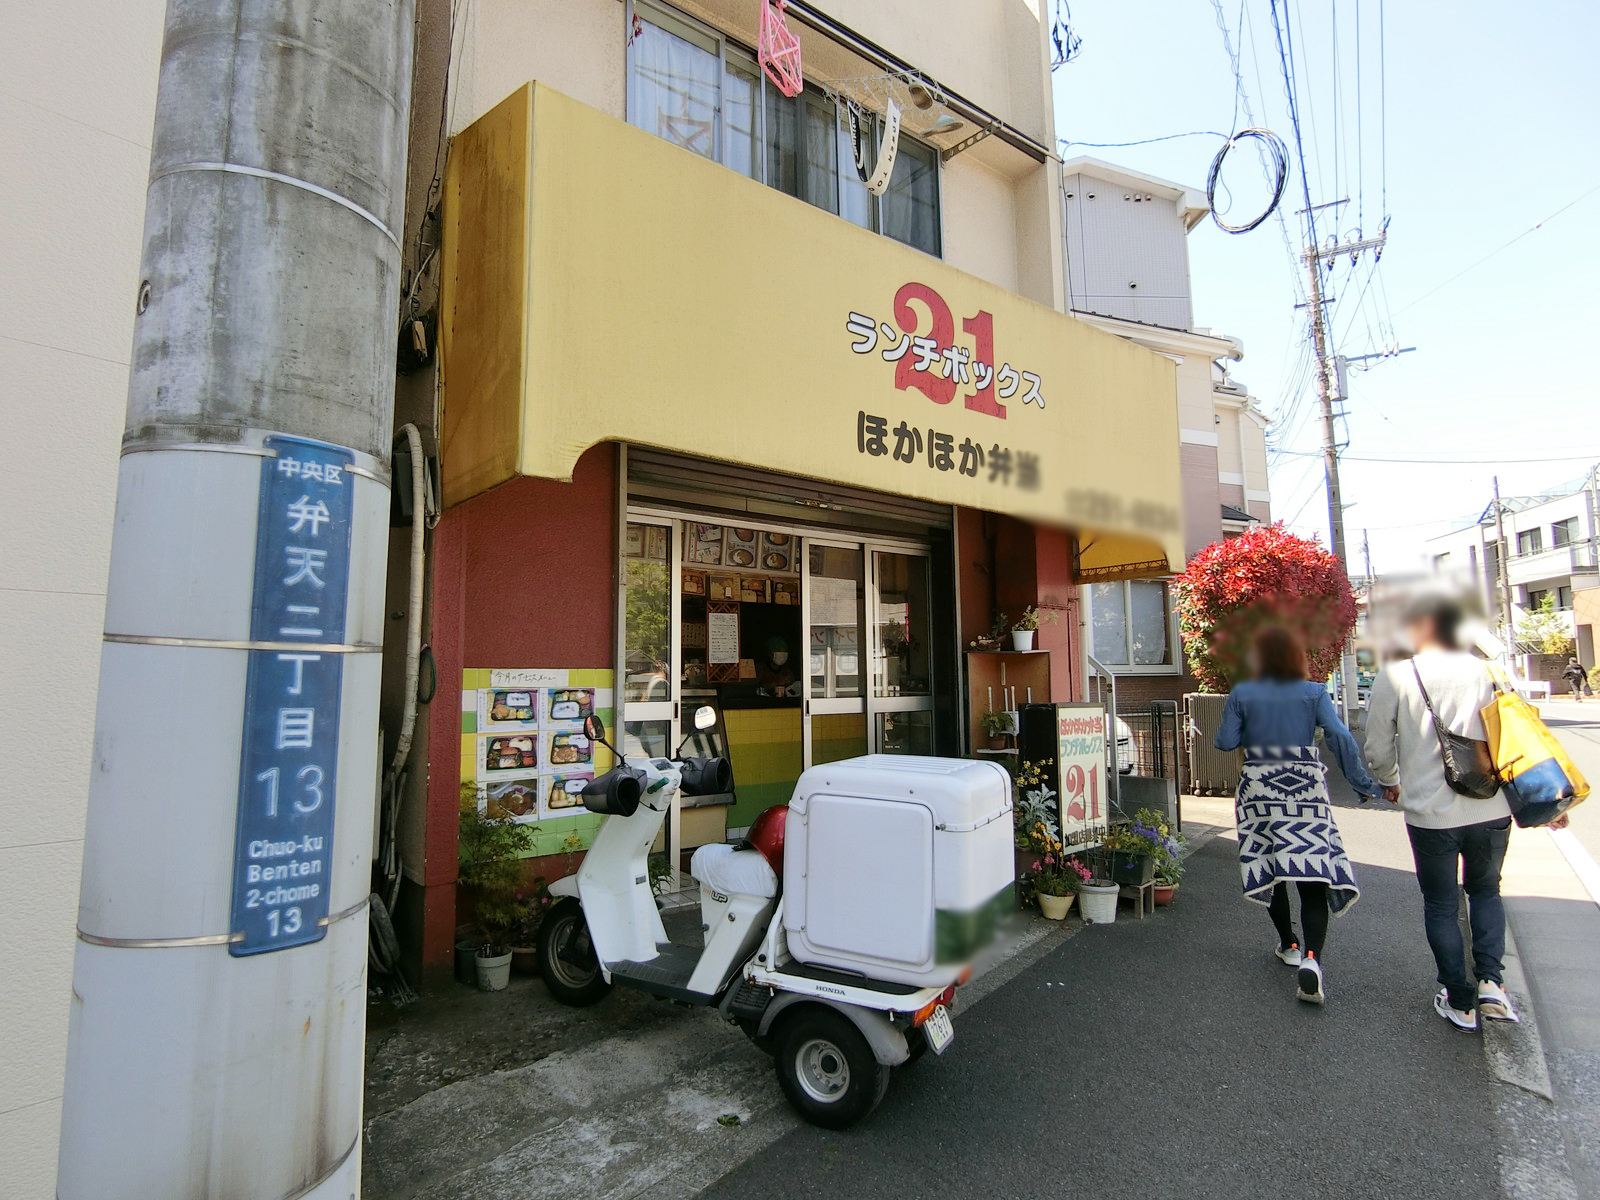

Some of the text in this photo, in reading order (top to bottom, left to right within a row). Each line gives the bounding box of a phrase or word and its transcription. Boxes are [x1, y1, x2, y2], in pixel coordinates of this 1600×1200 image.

[846, 311, 1045, 408] ランチボックス
[893, 282, 1007, 420] 21
[278, 457, 342, 484] 中央区
[276, 495, 329, 749] 弁天二丁目
[257, 764, 325, 817] 13
[1066, 762, 1102, 823] 21
[248, 834, 323, 858] Chuo-ku
[247, 860, 321, 883] Benten
[246, 884, 320, 908] 2-chome
[267, 907, 302, 937] 13
[816, 985, 846, 996] HONDA
